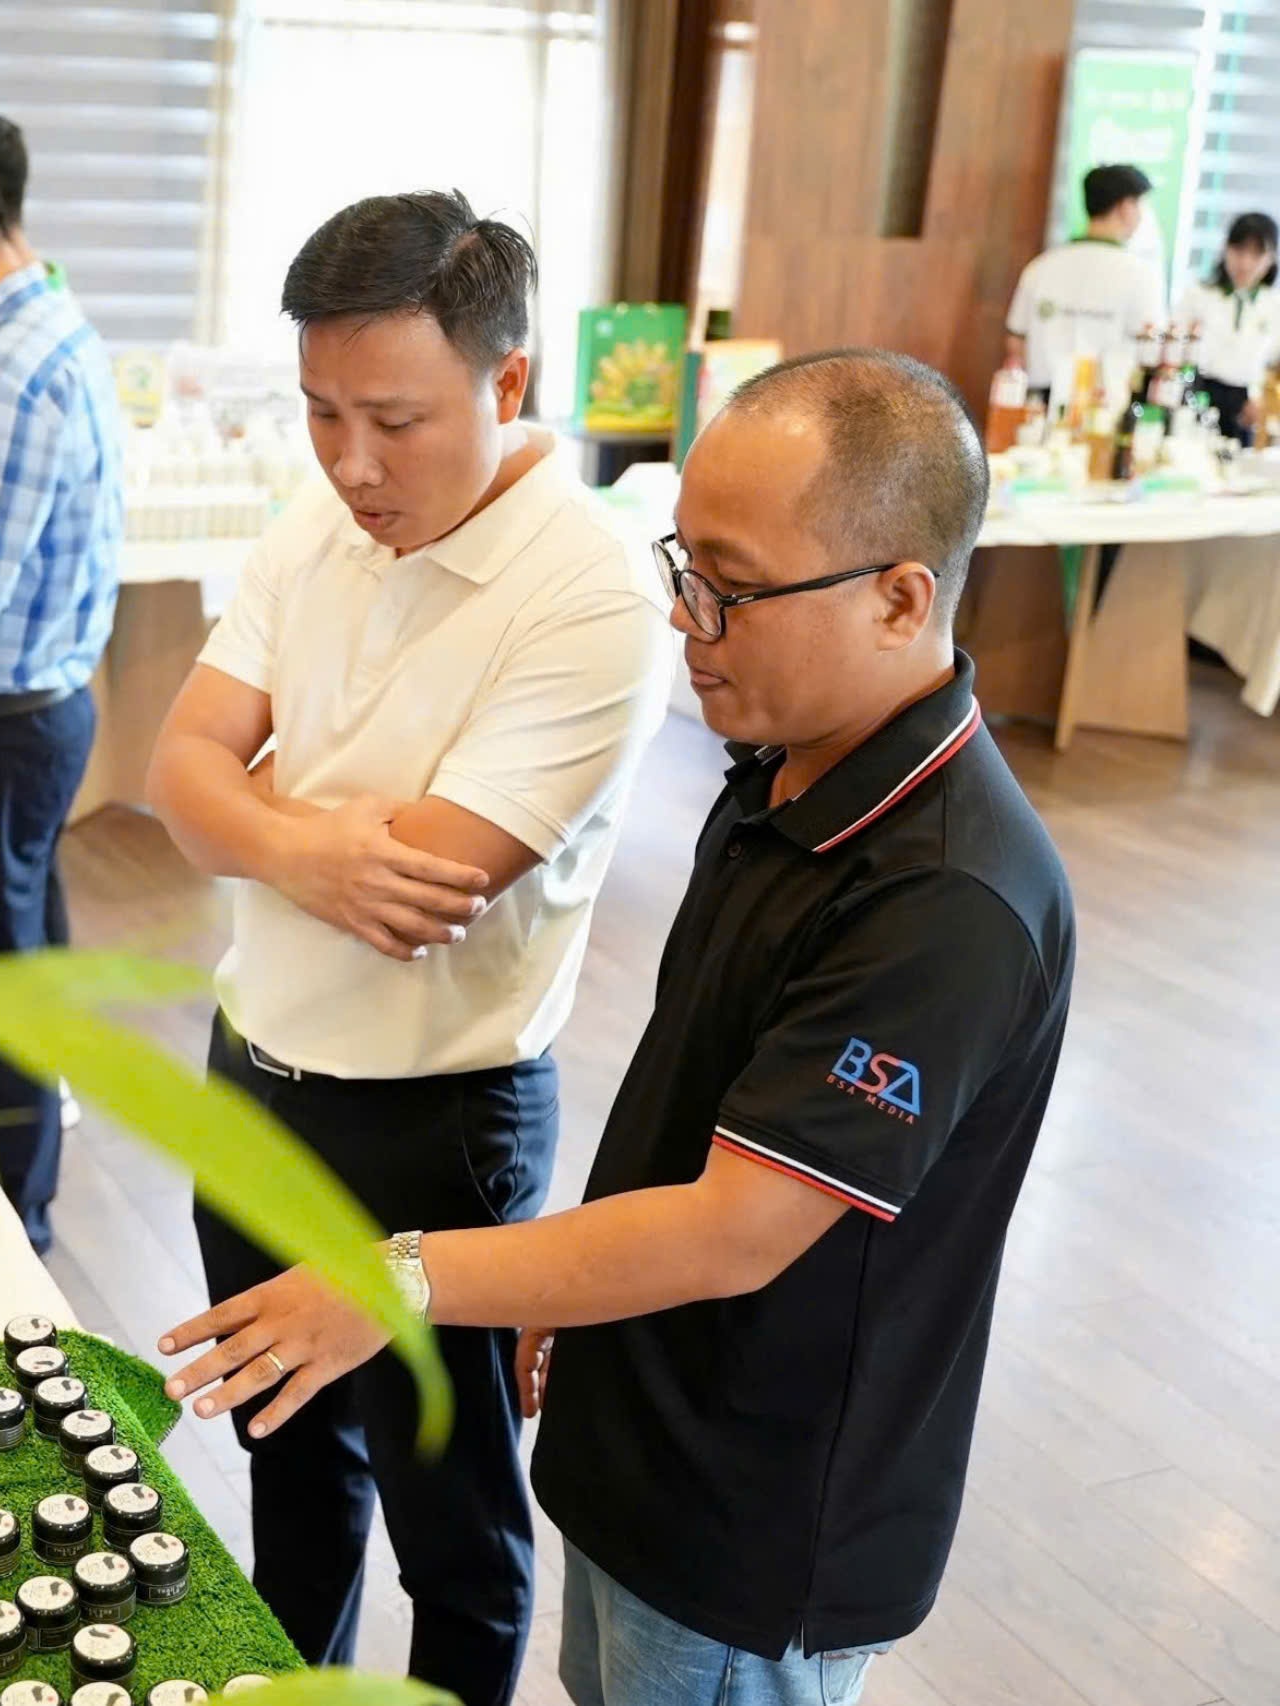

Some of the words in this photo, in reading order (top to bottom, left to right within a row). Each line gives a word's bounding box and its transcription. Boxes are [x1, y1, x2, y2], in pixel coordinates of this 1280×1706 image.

[826, 1074, 855, 1095] BSA
[864, 1095, 914, 1125] MEDIA
[832, 1037, 920, 1116] BSA
